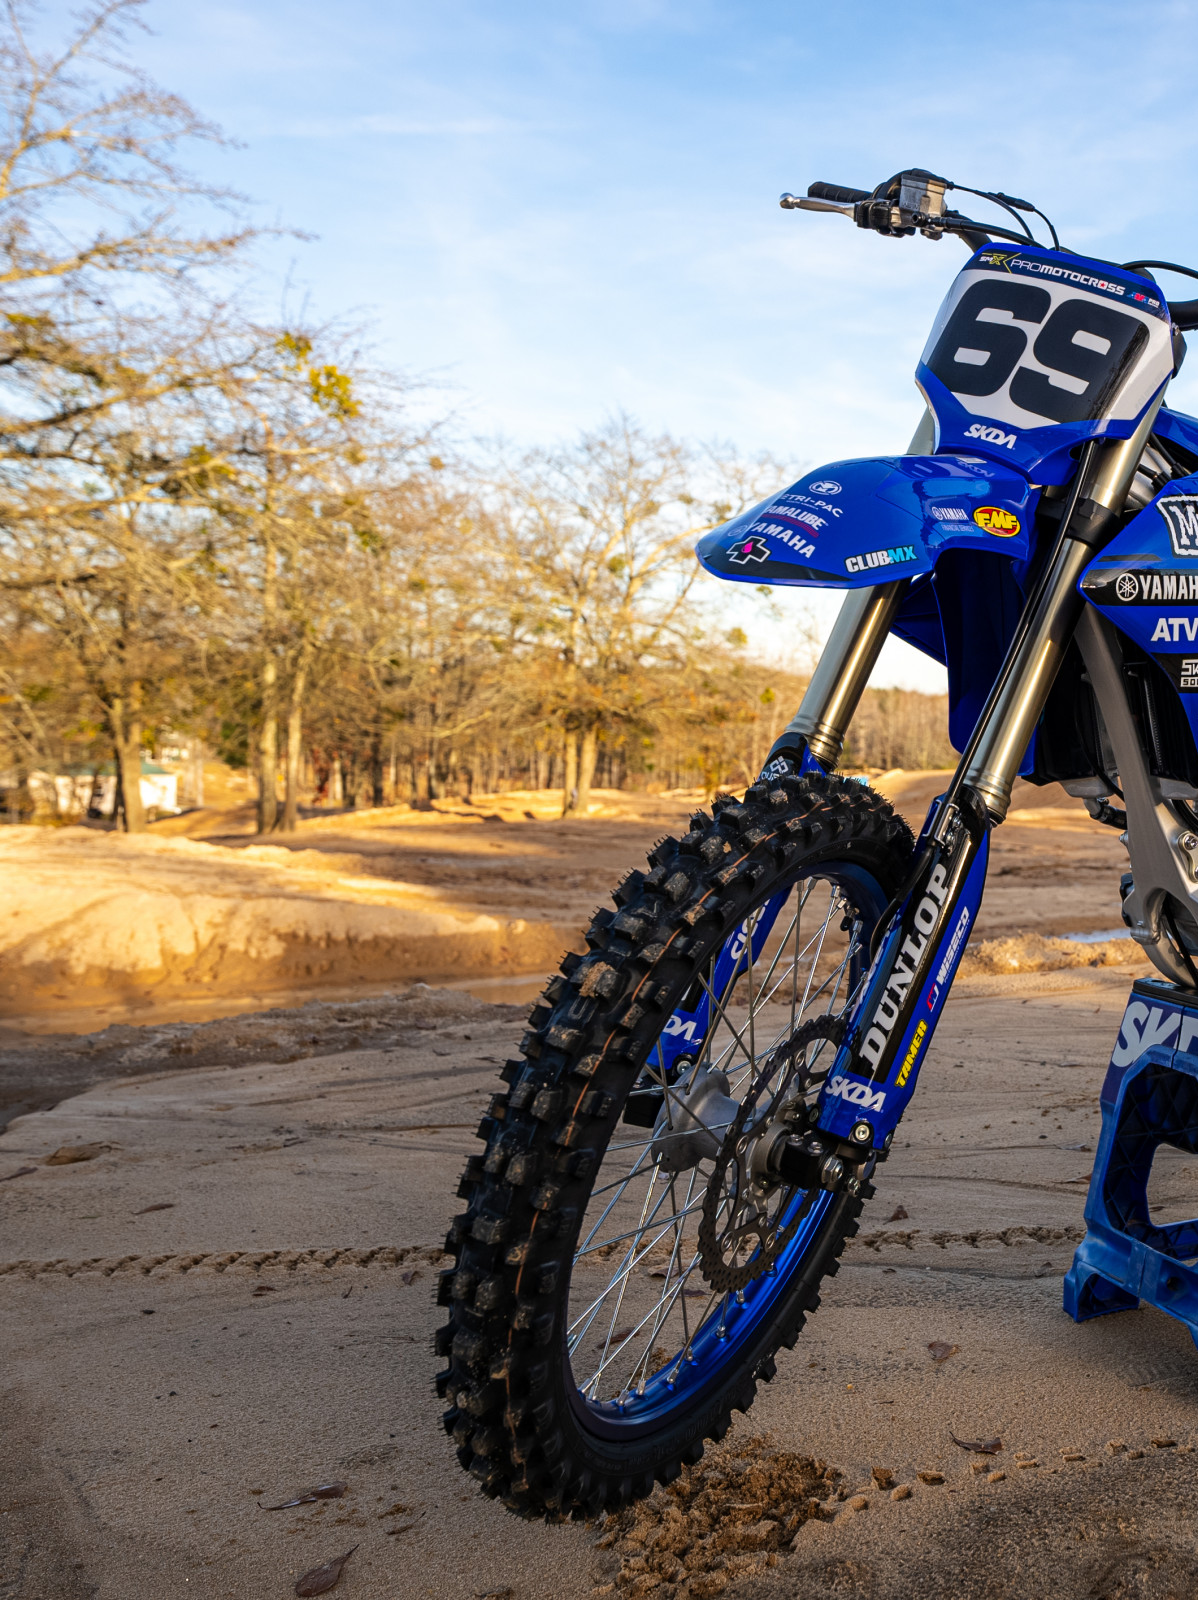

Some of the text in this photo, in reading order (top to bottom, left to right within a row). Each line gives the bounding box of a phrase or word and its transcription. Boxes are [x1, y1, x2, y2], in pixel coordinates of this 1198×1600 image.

[925, 278, 1150, 424] 69
[964, 423, 1017, 450] SKDA
[766, 505, 826, 531] AMALUBE
[780, 493, 843, 518] ETRI-PAC
[939, 507, 969, 521] YAMAHA
[976, 510, 1017, 529] FMF
[845, 546, 917, 573] CLUBMX
[859, 863, 950, 1071] DUNLOP
[662, 1014, 697, 1040] DA
[896, 1020, 928, 1088] TAMER
[825, 1075, 886, 1113] SKDA
